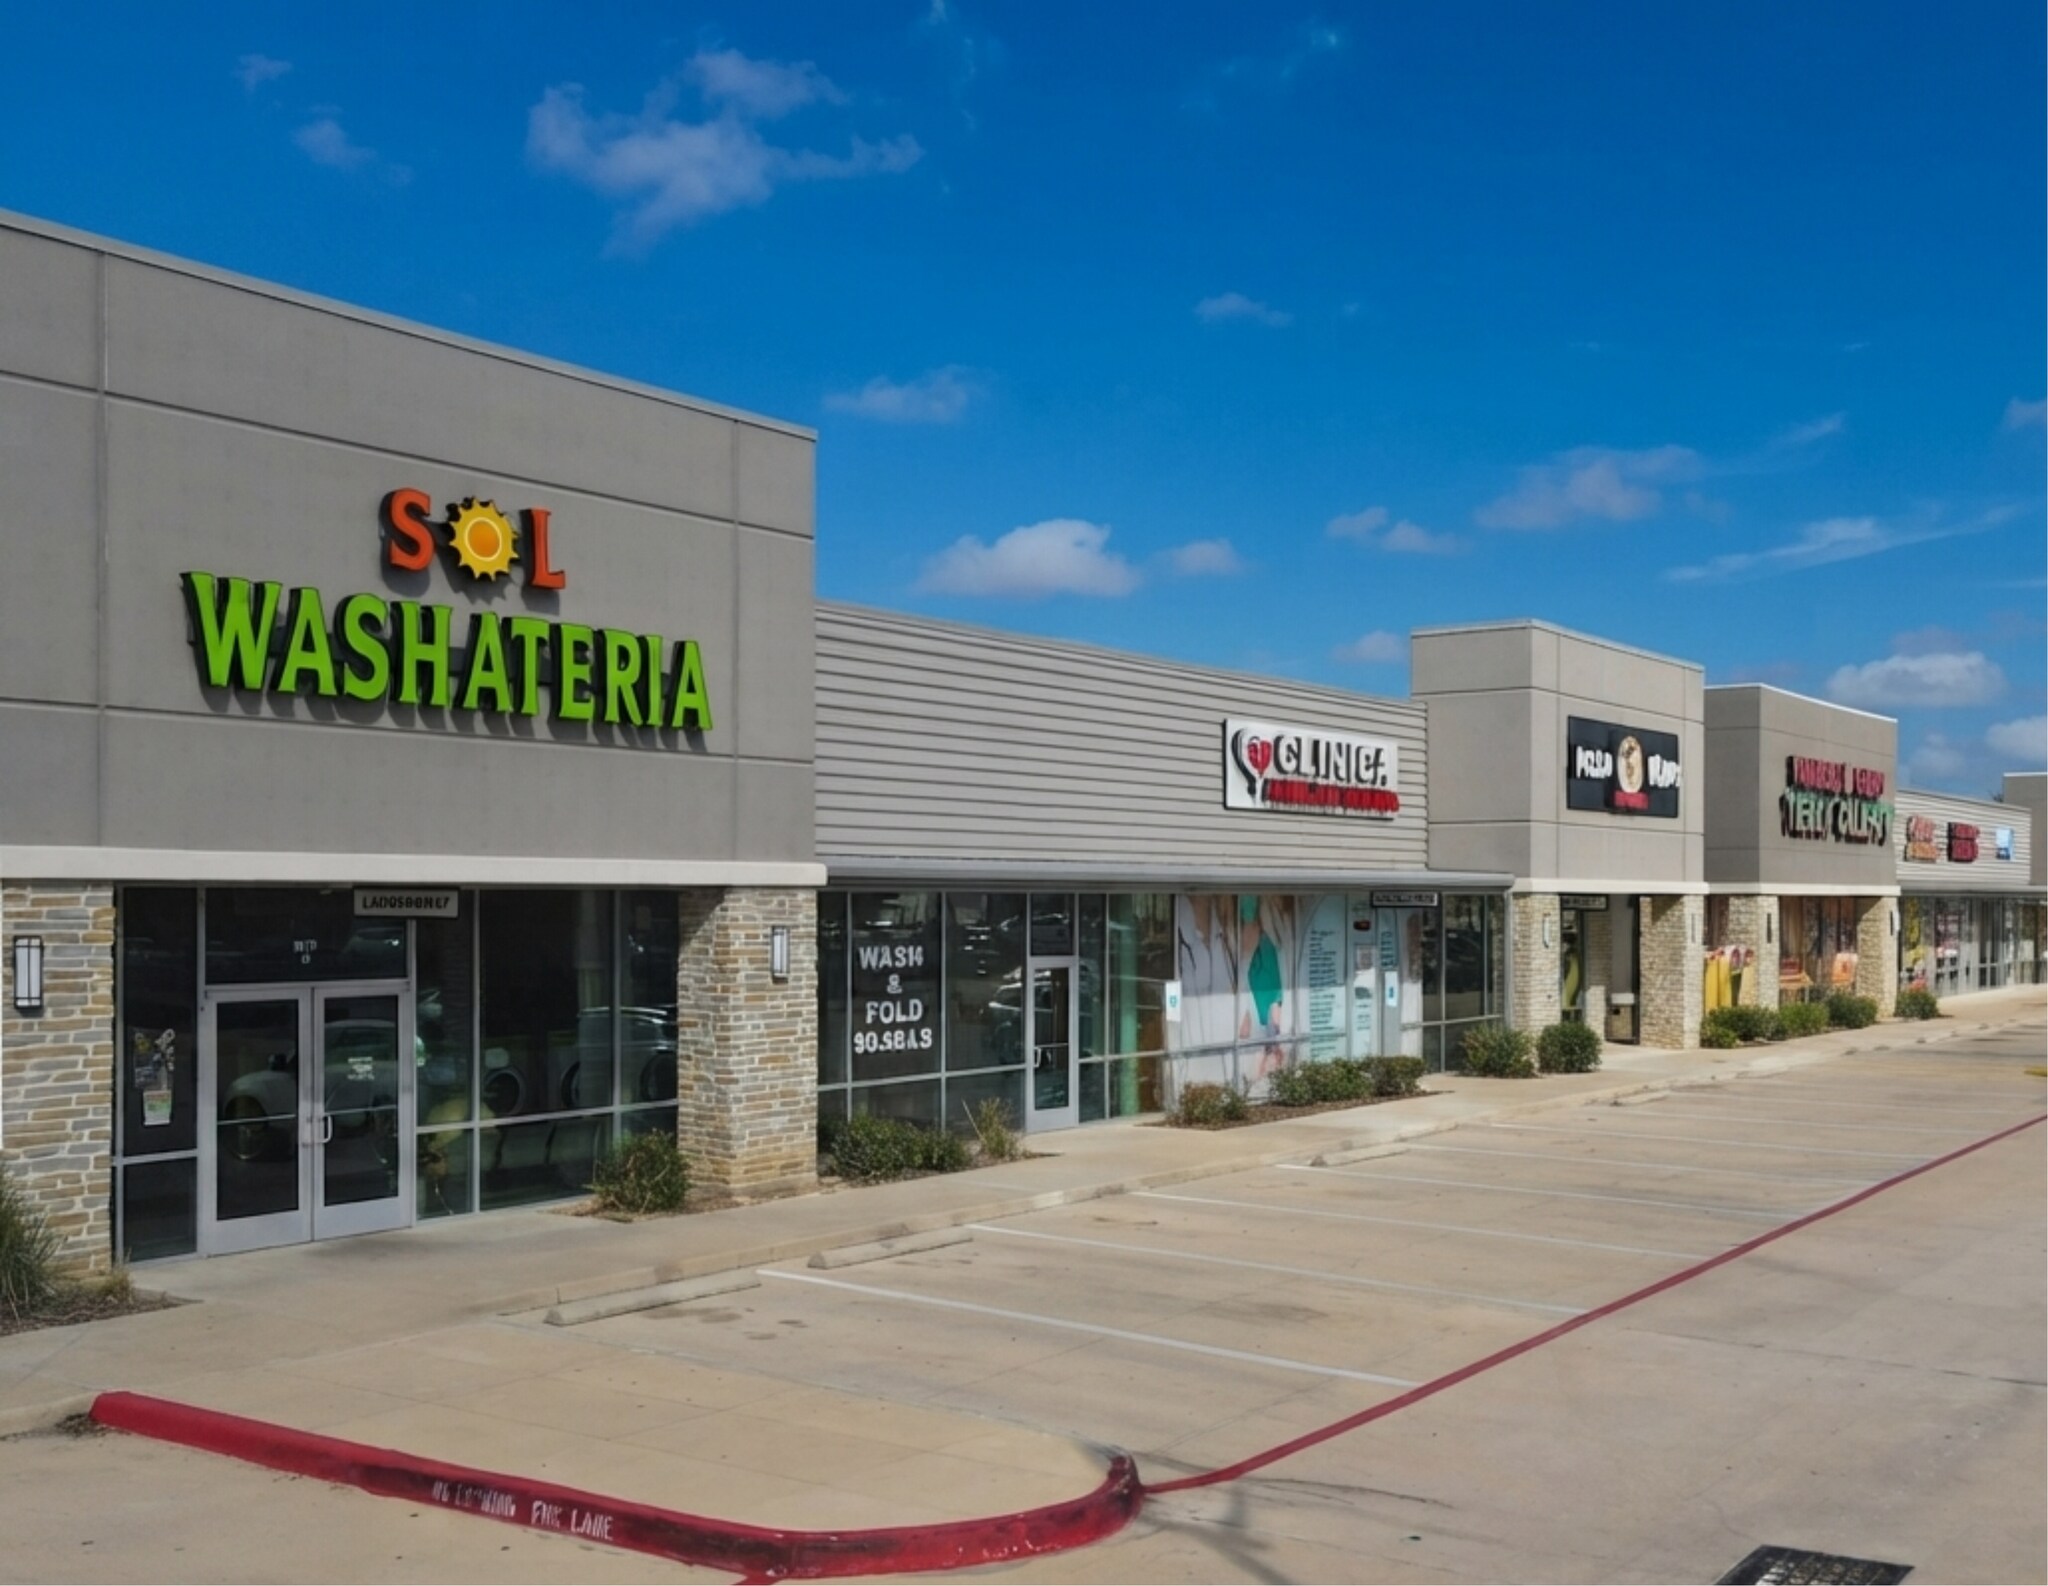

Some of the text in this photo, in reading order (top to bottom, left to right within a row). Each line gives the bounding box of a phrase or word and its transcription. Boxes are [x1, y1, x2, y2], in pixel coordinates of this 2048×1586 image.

[181, 570, 713, 732] WASHATERIA
[886, 973, 903, 994] &
[865, 998, 924, 1024] FOLD
